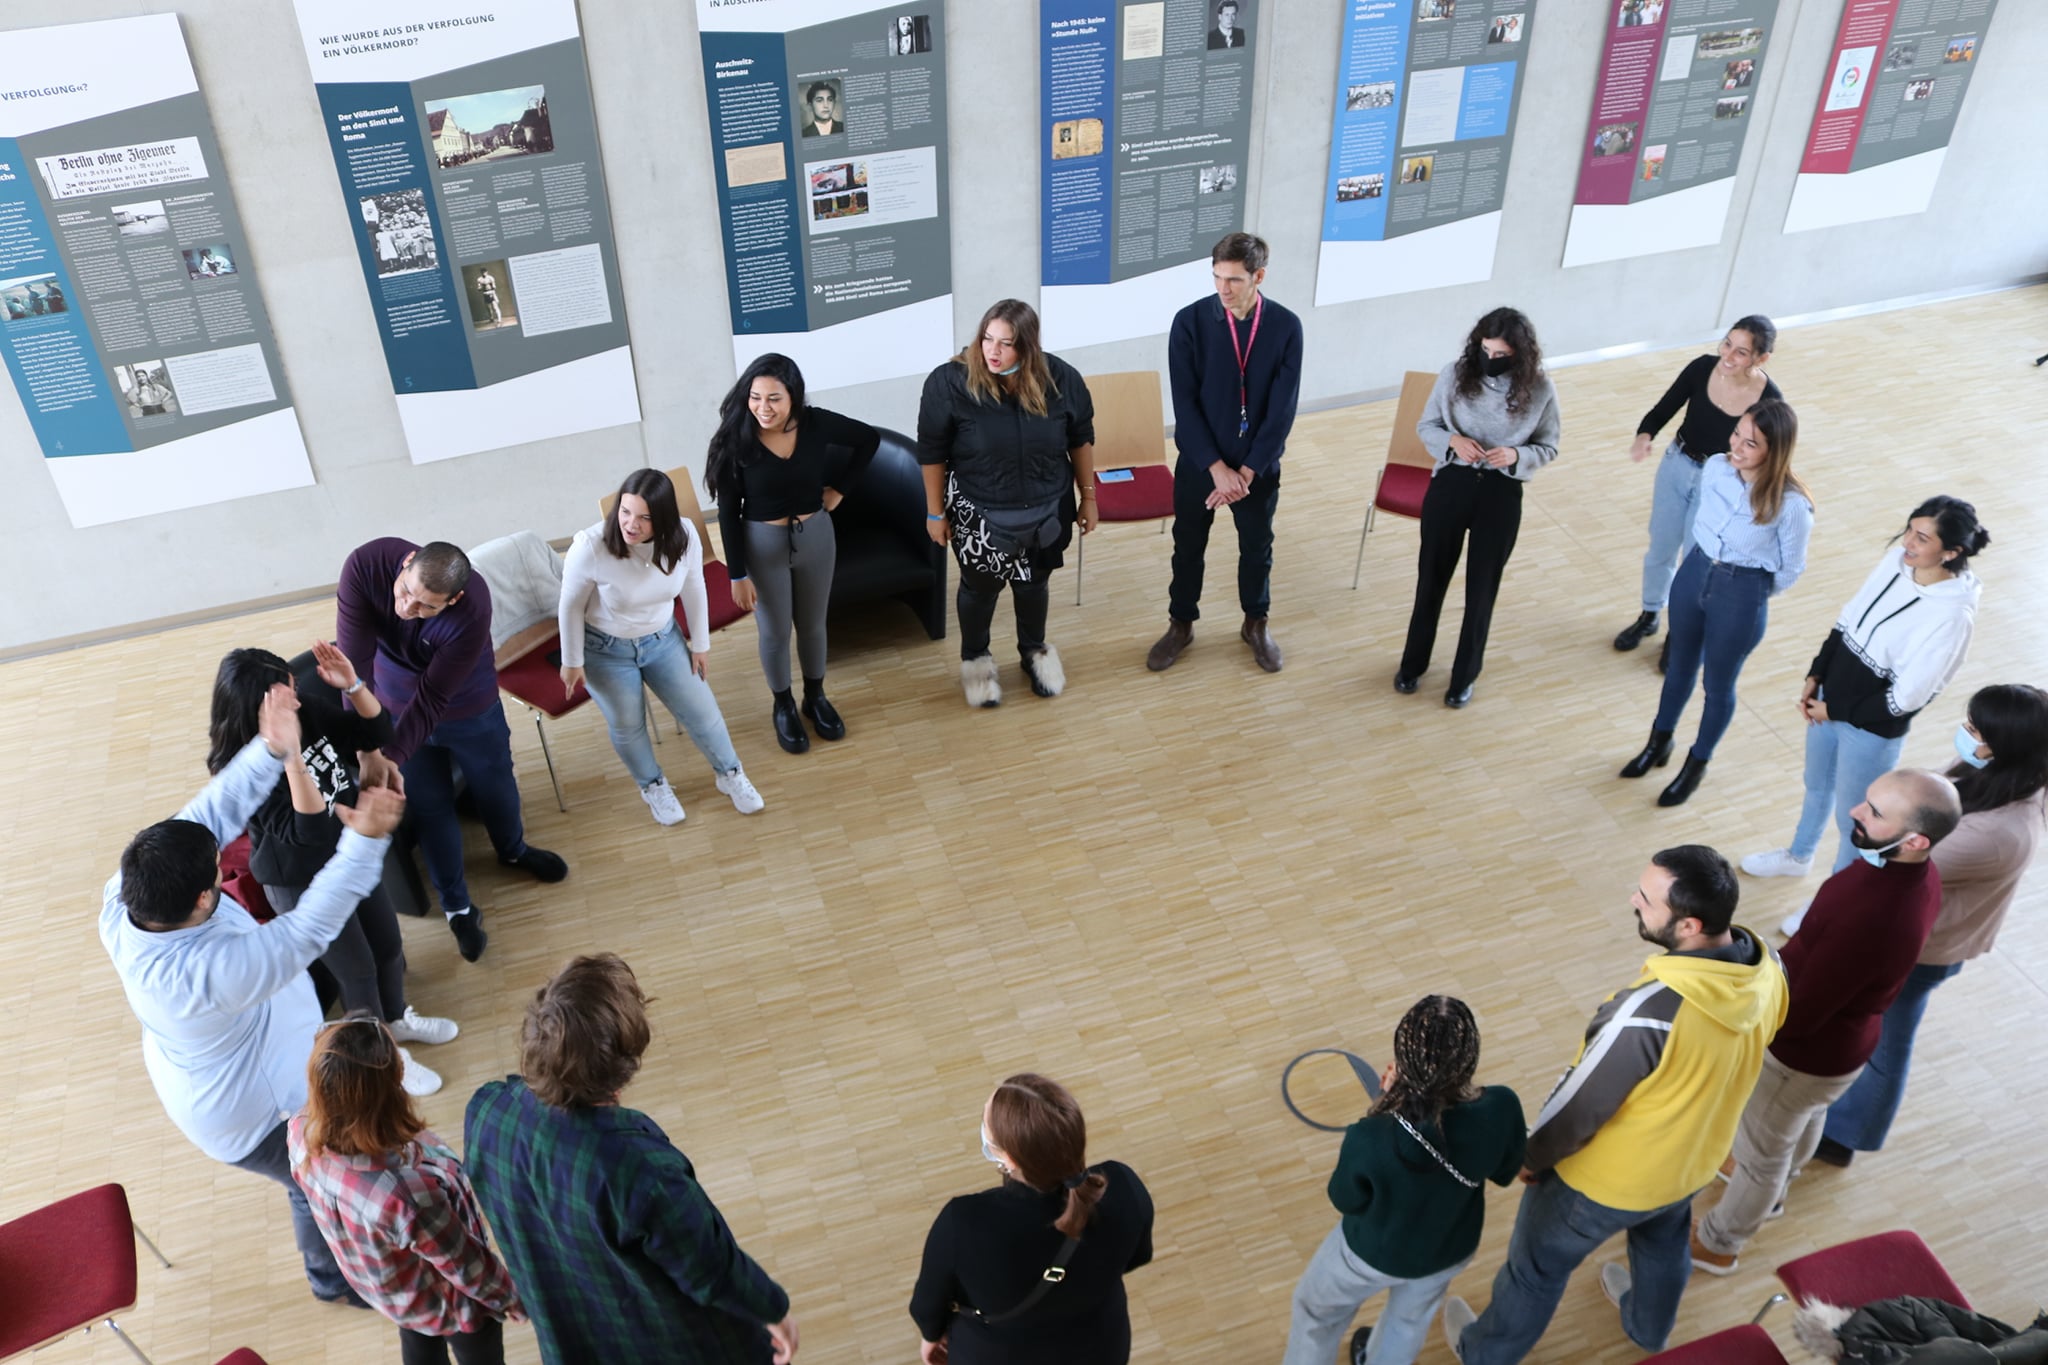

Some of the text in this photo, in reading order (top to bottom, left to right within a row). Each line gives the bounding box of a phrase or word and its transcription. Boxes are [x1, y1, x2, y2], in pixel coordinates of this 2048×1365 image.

[709, 0, 721, 8] IN
[1070, 18, 1087, 26] 1945:
[1088, 16, 1106, 24] keine
[319, 13, 495, 46] WIE WURDE AUS DER VERFOLGUNG
[322, 37, 419, 59] EIN VÖLKERMORD?
[715, 58, 754, 68] Auschwitz-
[716, 69, 749, 78] Birkenau
[1, 82, 88, 101] VERFOLGUNG«?
[338, 105, 399, 122] Der Völkermord
[340, 115, 405, 132] an den Sinti und
[343, 132, 366, 142] Roma
[58, 145, 177, 171] Berlin ohne Zigeuner
[743, 318, 752, 329] 6
[404, 376, 413, 388] 5
